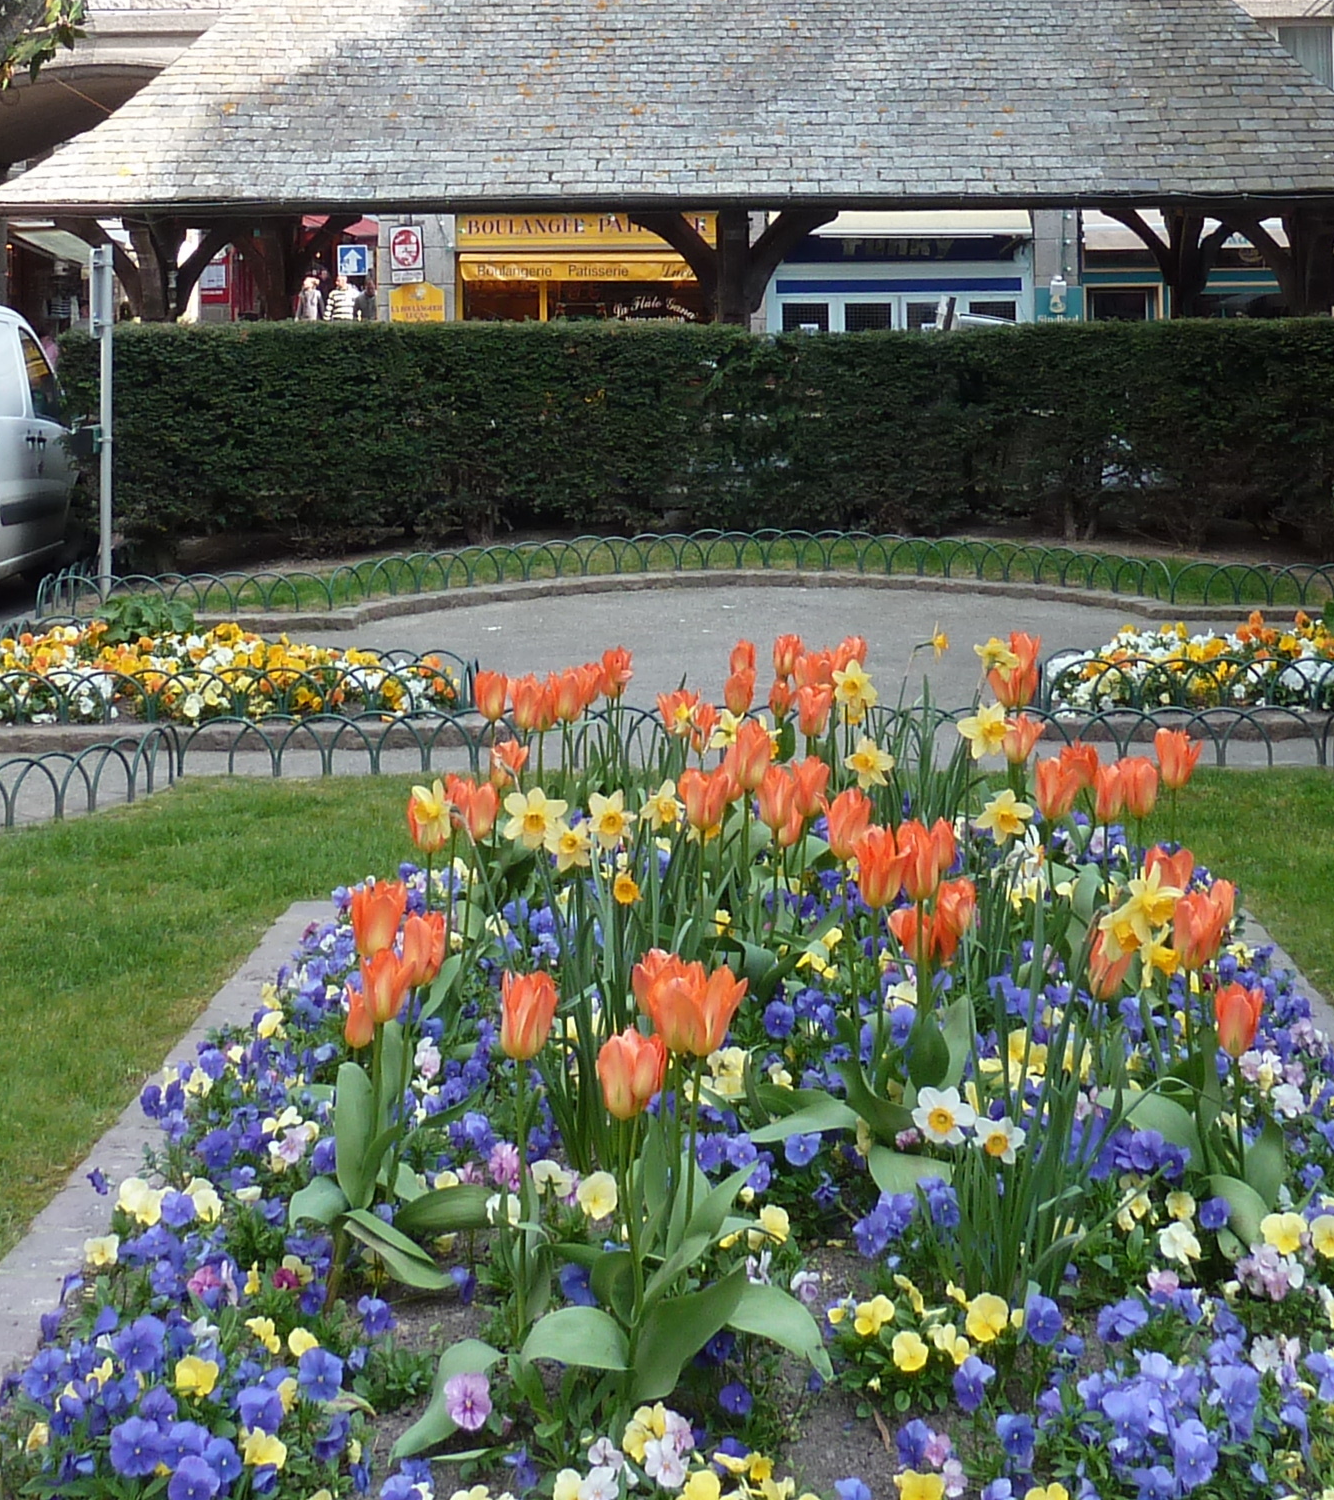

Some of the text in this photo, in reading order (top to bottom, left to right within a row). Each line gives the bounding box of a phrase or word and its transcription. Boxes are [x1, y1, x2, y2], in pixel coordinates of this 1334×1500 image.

[477, 262, 695, 278] Boulangerie Patisserie Luca
